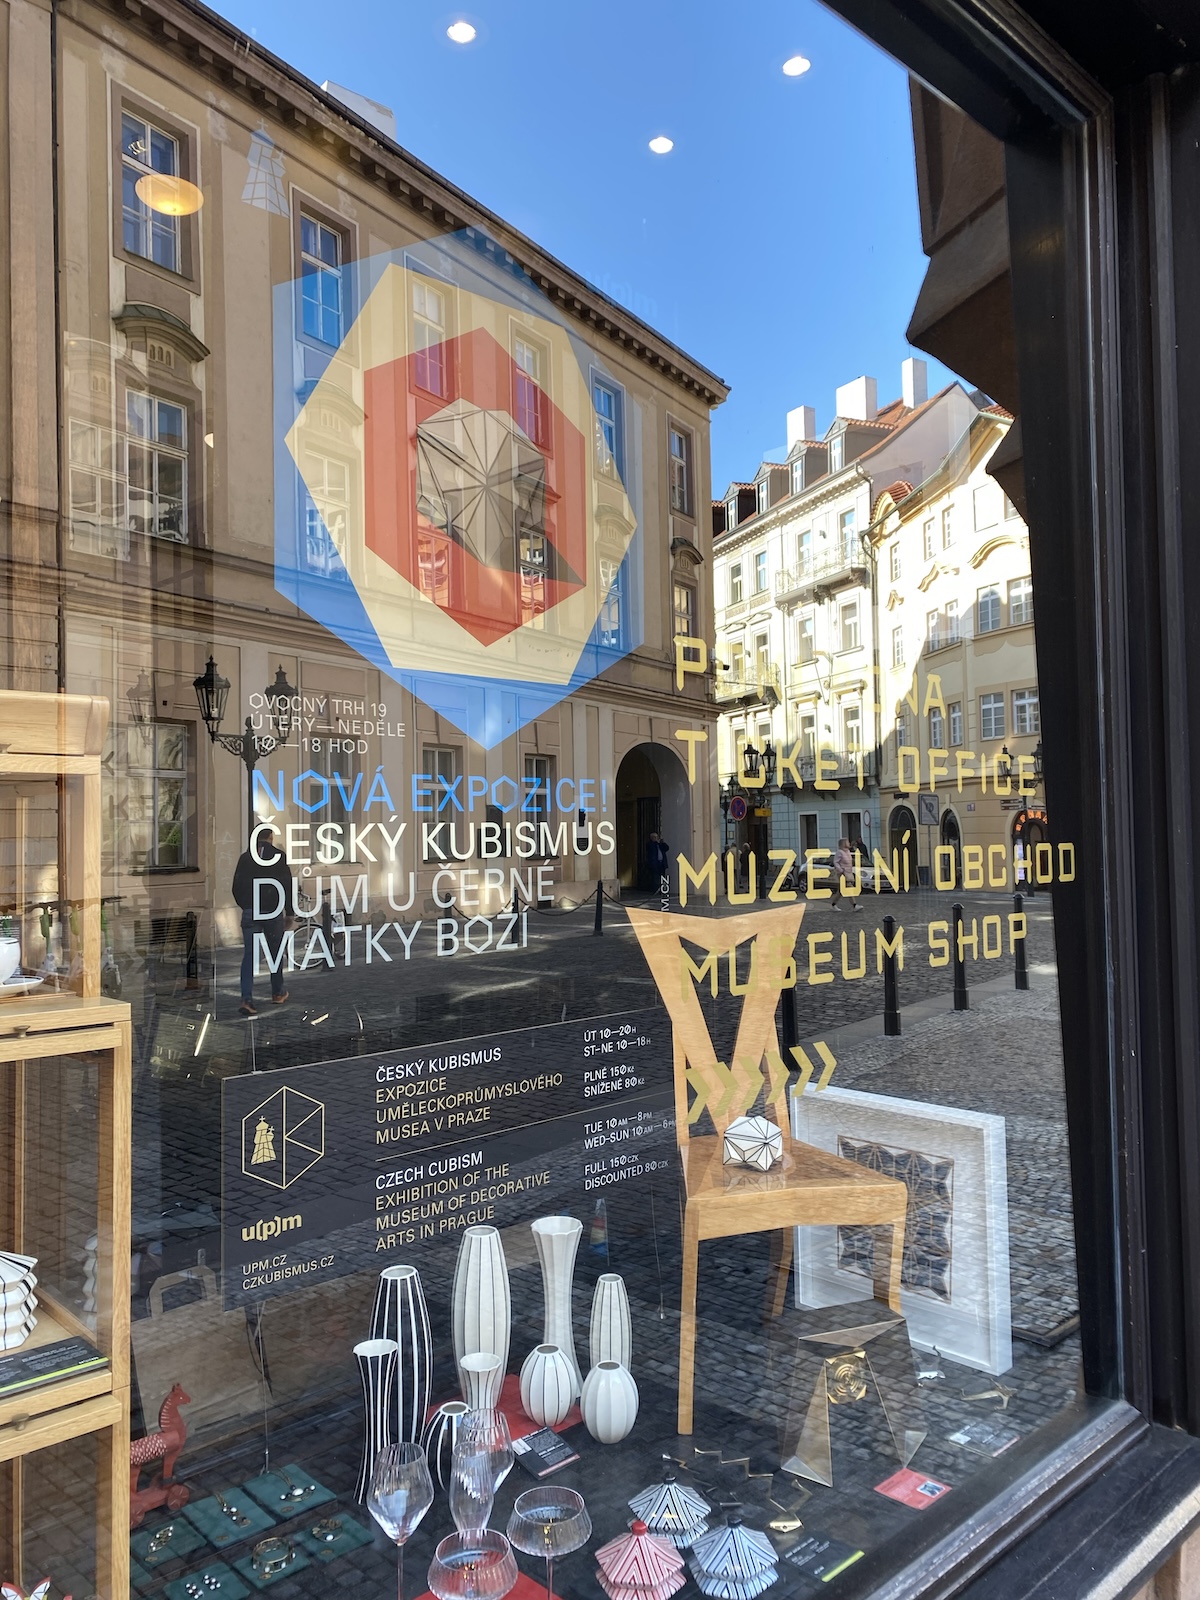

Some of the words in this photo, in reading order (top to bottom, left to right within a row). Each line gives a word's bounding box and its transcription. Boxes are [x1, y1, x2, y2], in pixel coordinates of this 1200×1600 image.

[249, 692, 327, 713] OVOCNÝ
[332, 699, 364, 716] TRH
[370, 703, 387, 717] 19
[329, 738, 369, 754] HOD
[674, 729, 873, 791] TCKET
[898, 745, 1037, 797] OFFICE
[252, 765, 395, 814] NOVÁ
[412, 773, 608, 814] EXPOZICE!
[249, 814, 407, 867] ČESKÝ
[423, 820, 616, 861] KUBISMUS
[676, 830, 911, 908] MUZEJNÍ
[934, 842, 1075, 891] OBCHOD
[253, 867, 368, 922] DŮM
[387, 871, 415, 912] U
[432, 860, 555, 909] ČERNÉ
[253, 920, 422, 976] MATKY
[437, 906, 529, 957] BOŽÍ
[679, 924, 904, 1003] MUSEUM
[928, 912, 1027, 967] SHOP
[584, 1030, 597, 1042] ÚT
[375, 1058, 425, 1083] ČESKÝ
[429, 1047, 502, 1073] KUBISMUS
[584, 1067, 607, 1082] PLNÉ
[376, 1076, 447, 1104] EXPOZICE
[376, 1072, 563, 1124] UMĚLECKOPRŮMYSLOVÉHO
[584, 1078, 622, 1097] SNÍŽENÉ
[376, 1120, 430, 1144] MUSEA
[434, 1117, 444, 1131] V
[448, 1106, 491, 1129] PRAZE
[584, 1121, 603, 1135] TUE
[375, 1165, 424, 1190] CZECH
[428, 1150, 483, 1177] CUBISM
[375, 1176, 459, 1211] EXHIBITION
[462, 1170, 481, 1187] OF
[484, 1162, 510, 1181] THE
[584, 1161, 607, 1176] FULL
[585, 1164, 643, 1191] DISCOUNTED
[376, 1201, 444, 1231] MUSEUM
[448, 1194, 466, 1211] OF
[470, 1170, 550, 1205] DECORATIVE
[375, 1228, 415, 1252] ARTS
[420, 1222, 434, 1239] IN
[439, 1205, 495, 1233] PRAGUE
[242, 1254, 288, 1276] UPM.CZ
[242, 1255, 335, 1290] CZKUBISMUS.CZ
